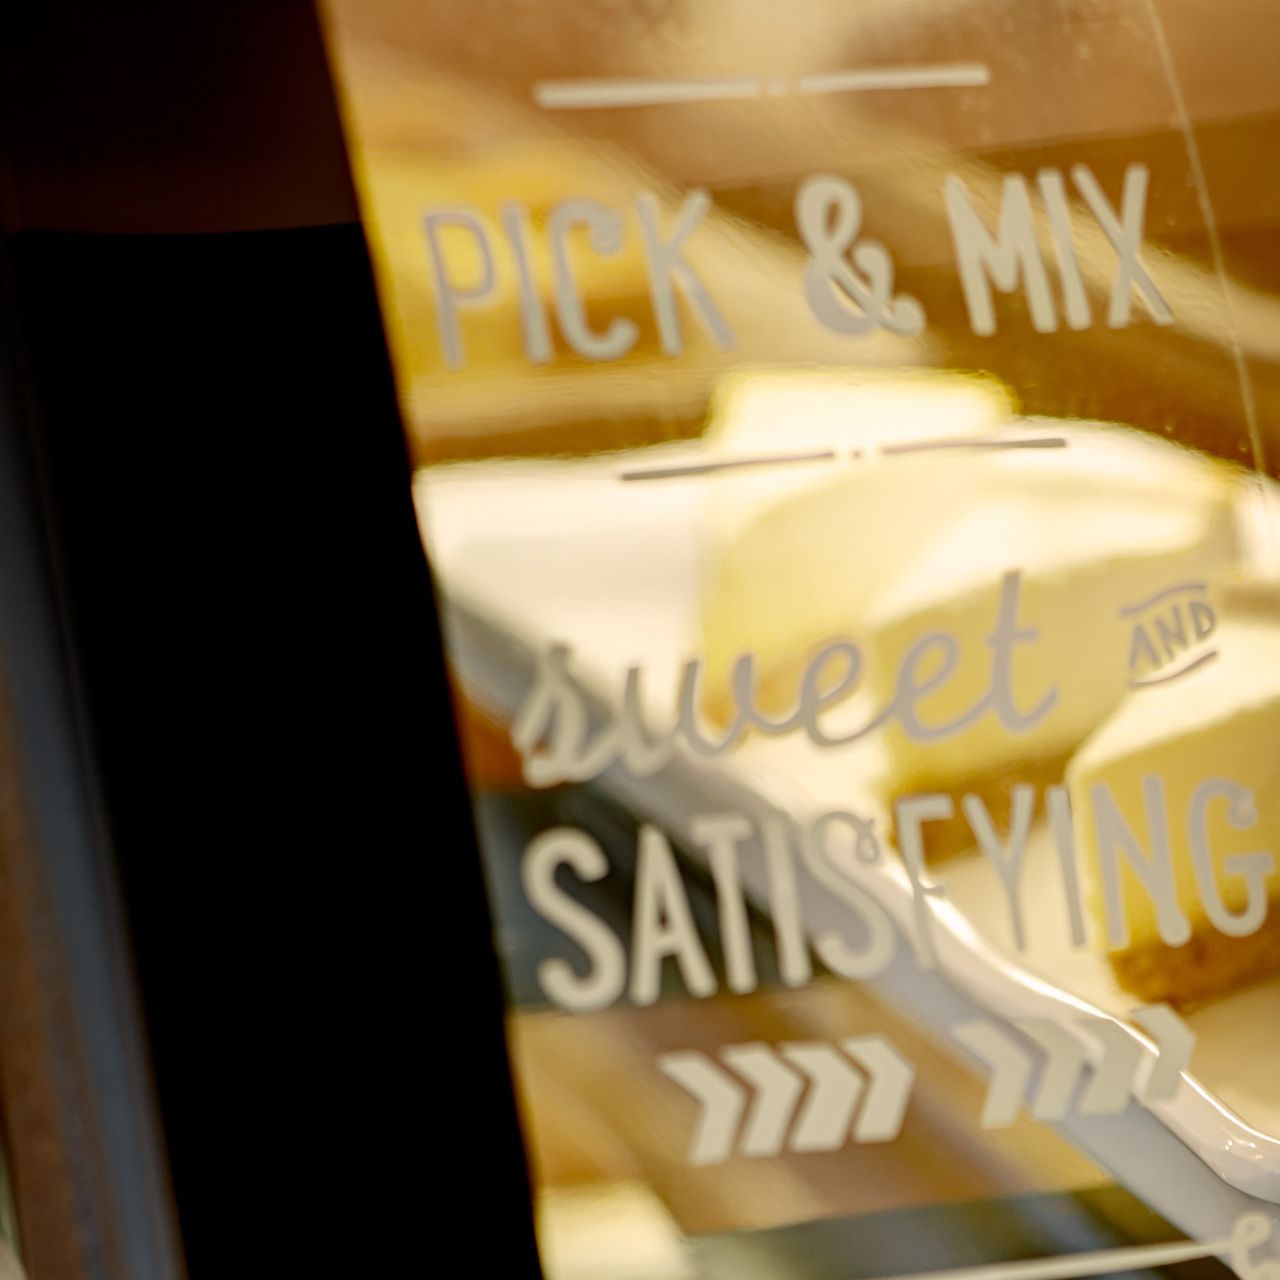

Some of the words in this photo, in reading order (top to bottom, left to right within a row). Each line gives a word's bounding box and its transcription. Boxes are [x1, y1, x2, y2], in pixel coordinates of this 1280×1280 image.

[424, 189, 735, 368] PICK
[797, 175, 925, 339] &
[943, 163, 1176, 337] MIX
[512, 569, 1060, 790] sweet
[1126, 598, 1218, 672] AND
[521, 773, 1275, 1013] SATISFYING
